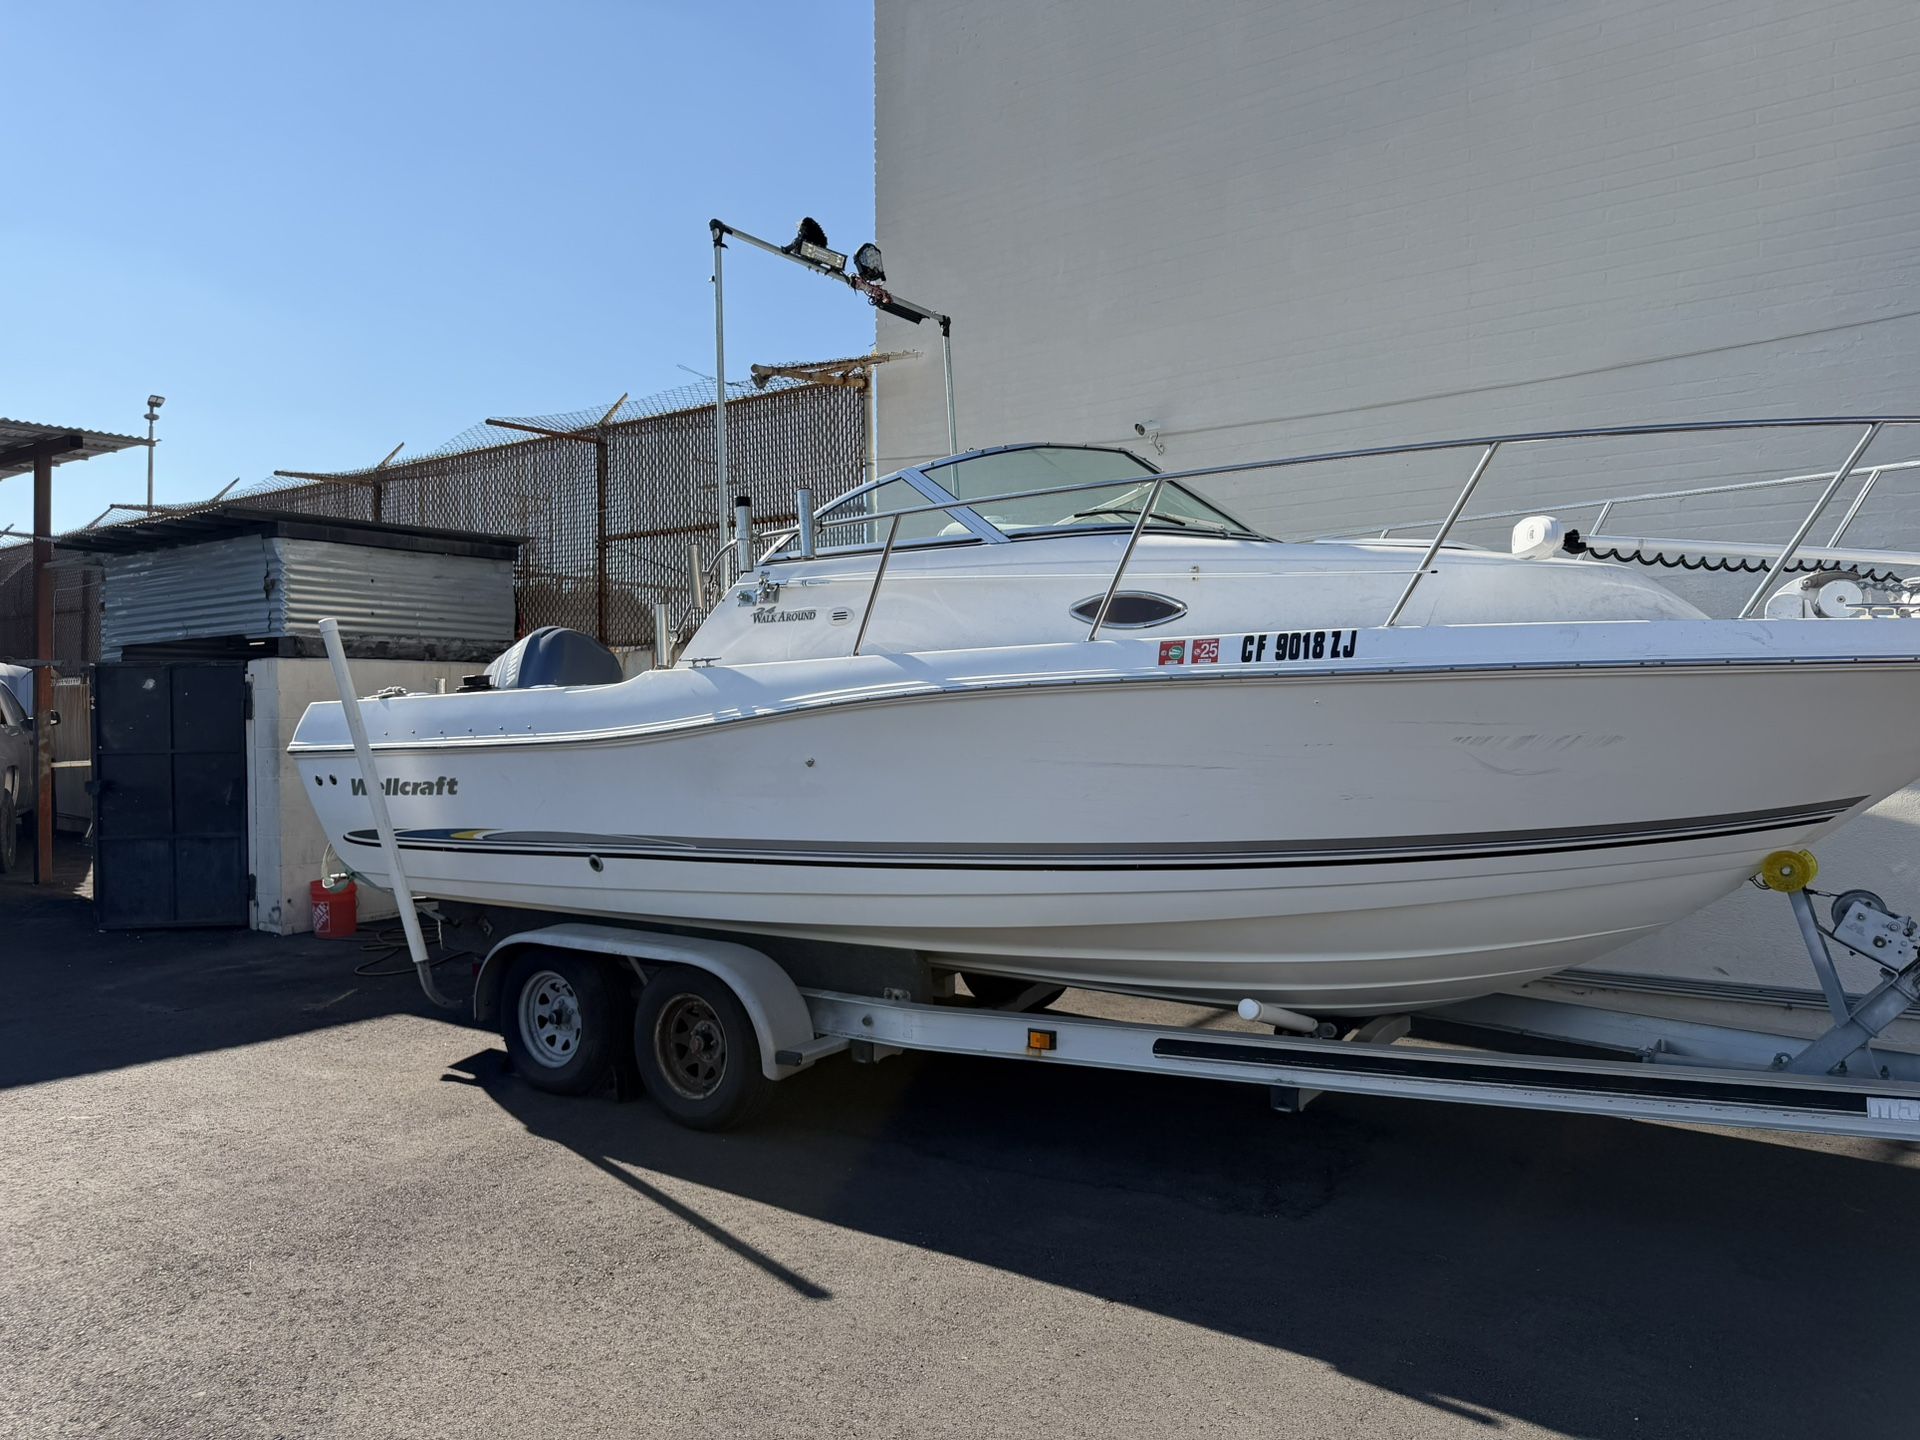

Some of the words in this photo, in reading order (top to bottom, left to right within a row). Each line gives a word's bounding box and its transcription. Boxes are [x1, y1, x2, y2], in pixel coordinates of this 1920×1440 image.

[752, 612, 777, 624] WALK
[778, 610, 817, 623] AROUND
[1200, 643, 1218, 658] 25
[1241, 635, 1267, 662] CF
[1275, 631, 1325, 661] 9018
[1330, 630, 1358, 659] ZJ
[351, 775, 458, 796] Wllcraft
